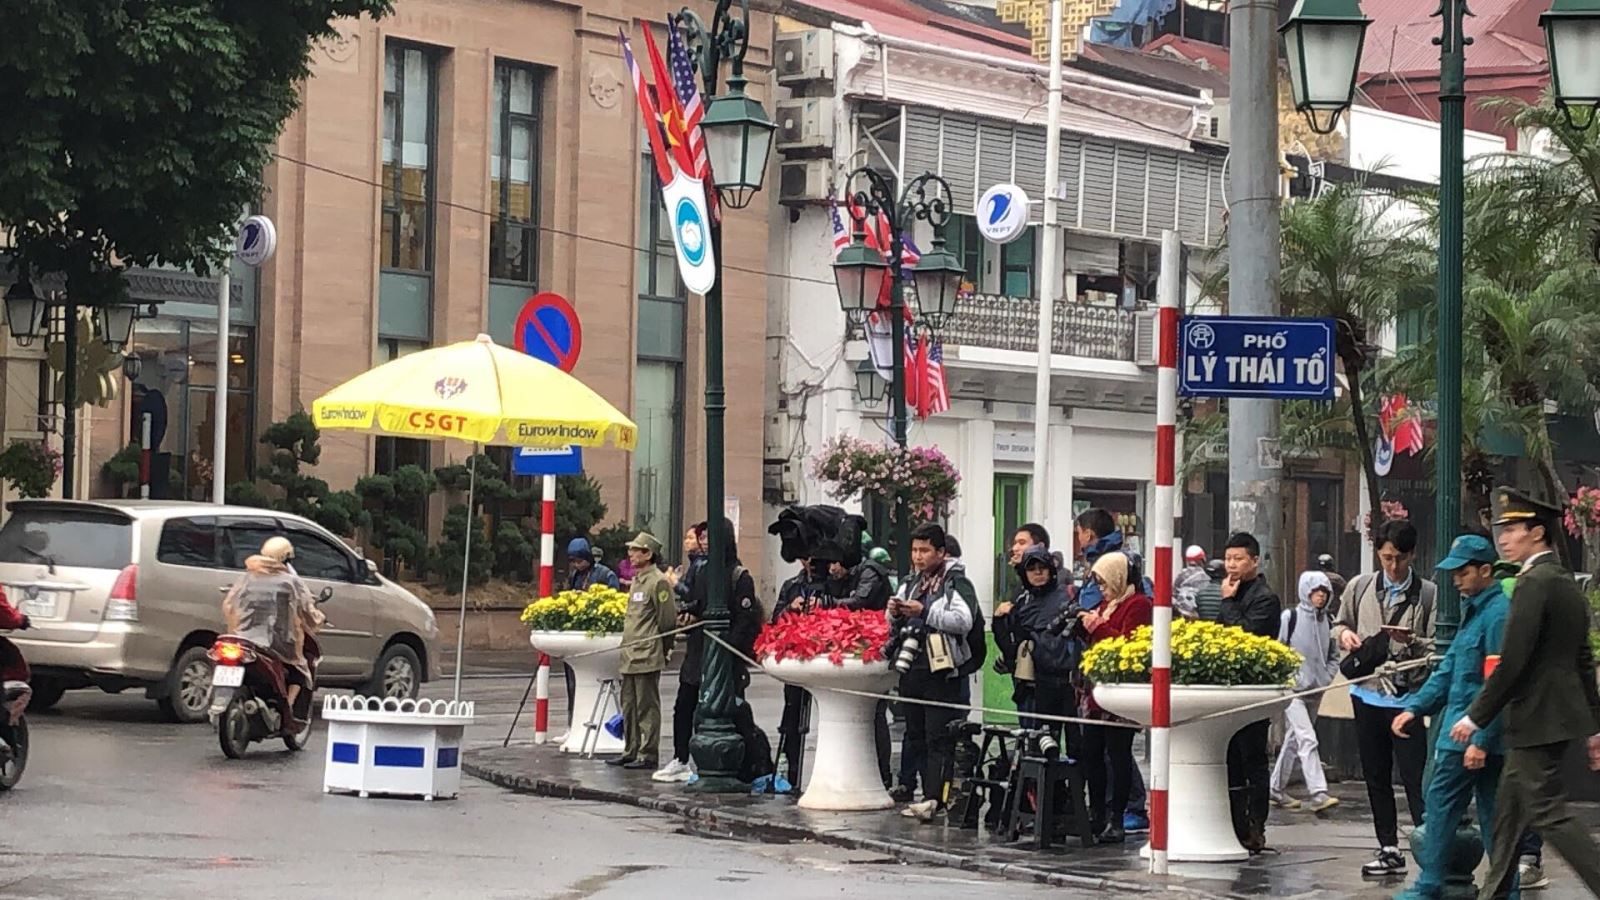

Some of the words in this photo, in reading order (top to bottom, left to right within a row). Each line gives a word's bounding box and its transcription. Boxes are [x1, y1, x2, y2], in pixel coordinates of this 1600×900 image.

[1243, 330, 1288, 349] PHỐ
[1187, 350, 1217, 382] LÝ
[1225, 351, 1285, 384] THÁI
[1293, 347, 1327, 385] TỔ
[409, 411, 468, 433] CSGT
